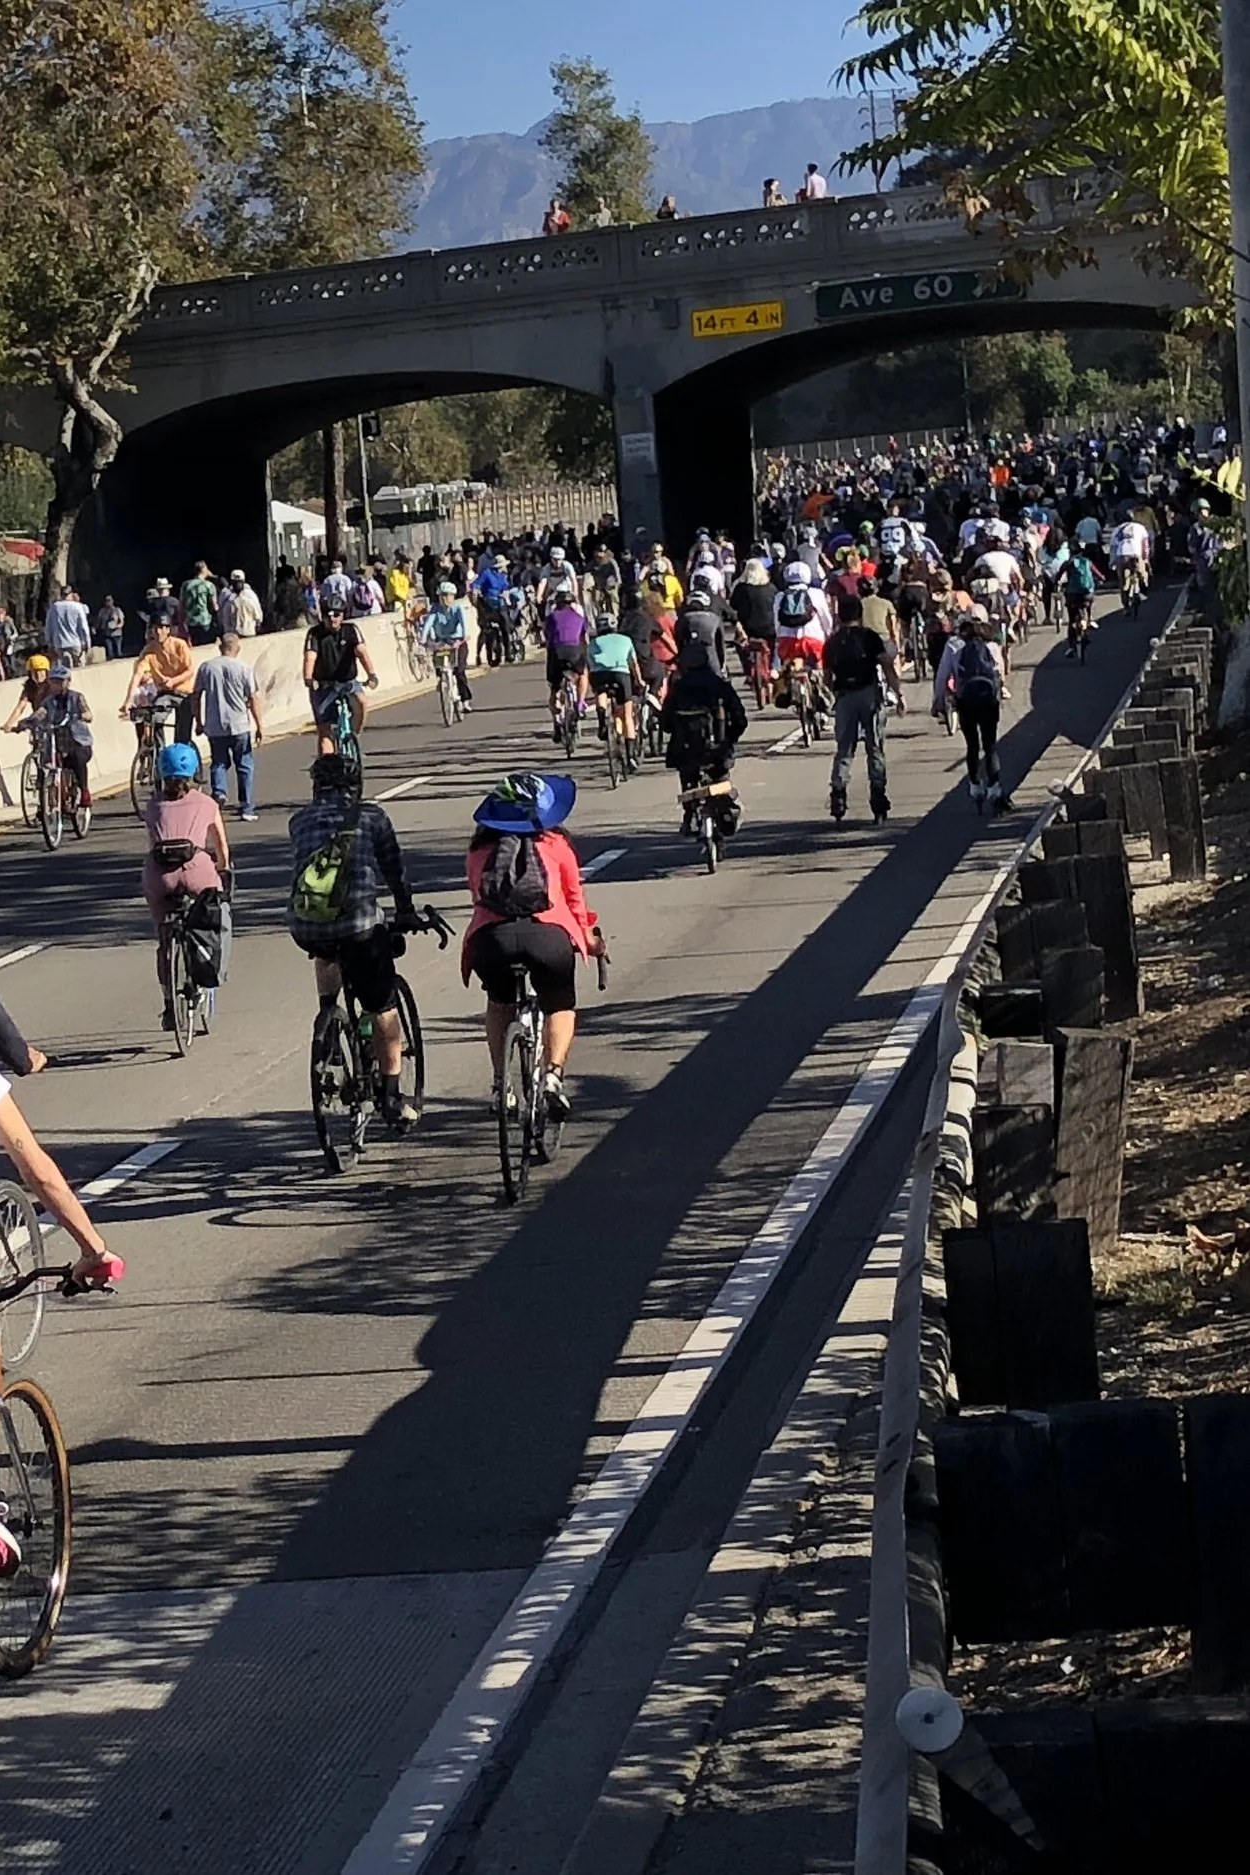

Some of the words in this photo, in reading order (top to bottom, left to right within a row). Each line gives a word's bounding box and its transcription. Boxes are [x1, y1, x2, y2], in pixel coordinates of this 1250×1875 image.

[839, 286, 894, 309] Ave
[913, 275, 953, 300] 60
[696, 314, 717, 332] 14
[720, 317, 736, 329] FT
[745, 309, 760, 326] 4
[765, 312, 779, 325] IN
